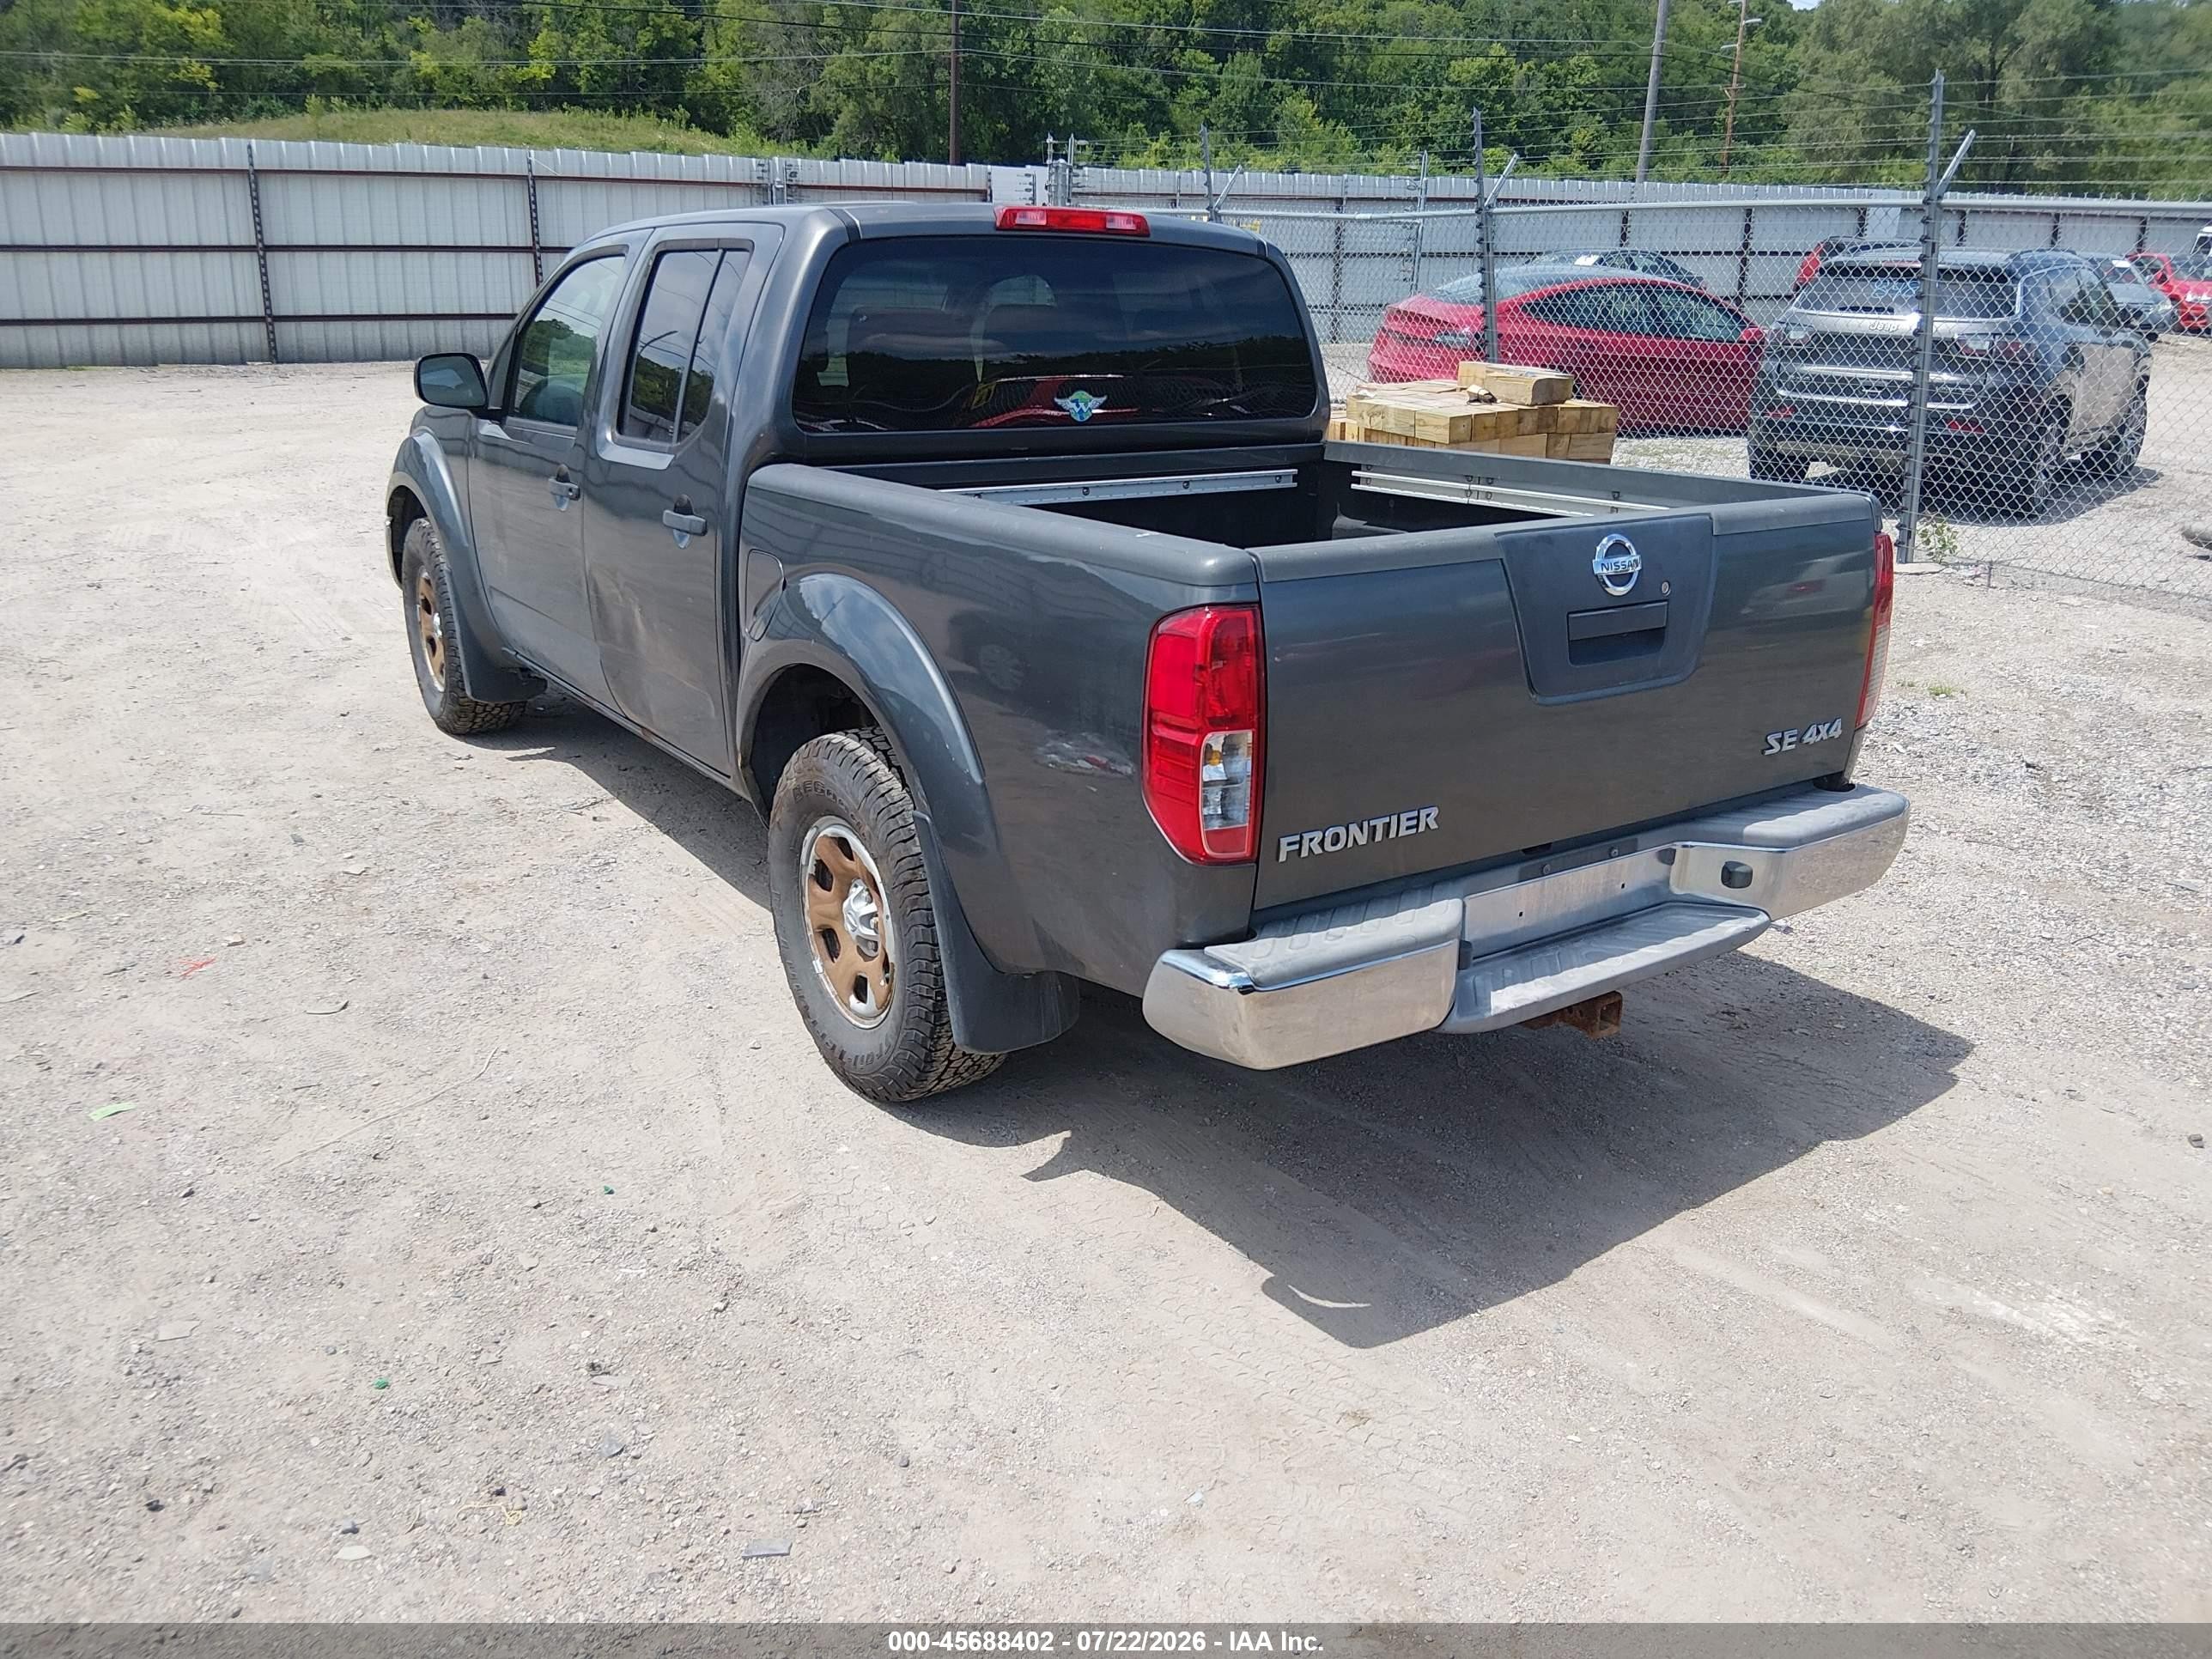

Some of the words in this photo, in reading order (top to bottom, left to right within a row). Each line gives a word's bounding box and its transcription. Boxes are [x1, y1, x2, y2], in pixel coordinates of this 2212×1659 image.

[1601, 559, 1639, 572] NISSAN
[1761, 729, 1798, 756] SE
[1278, 805, 1439, 863] FRONTIER
